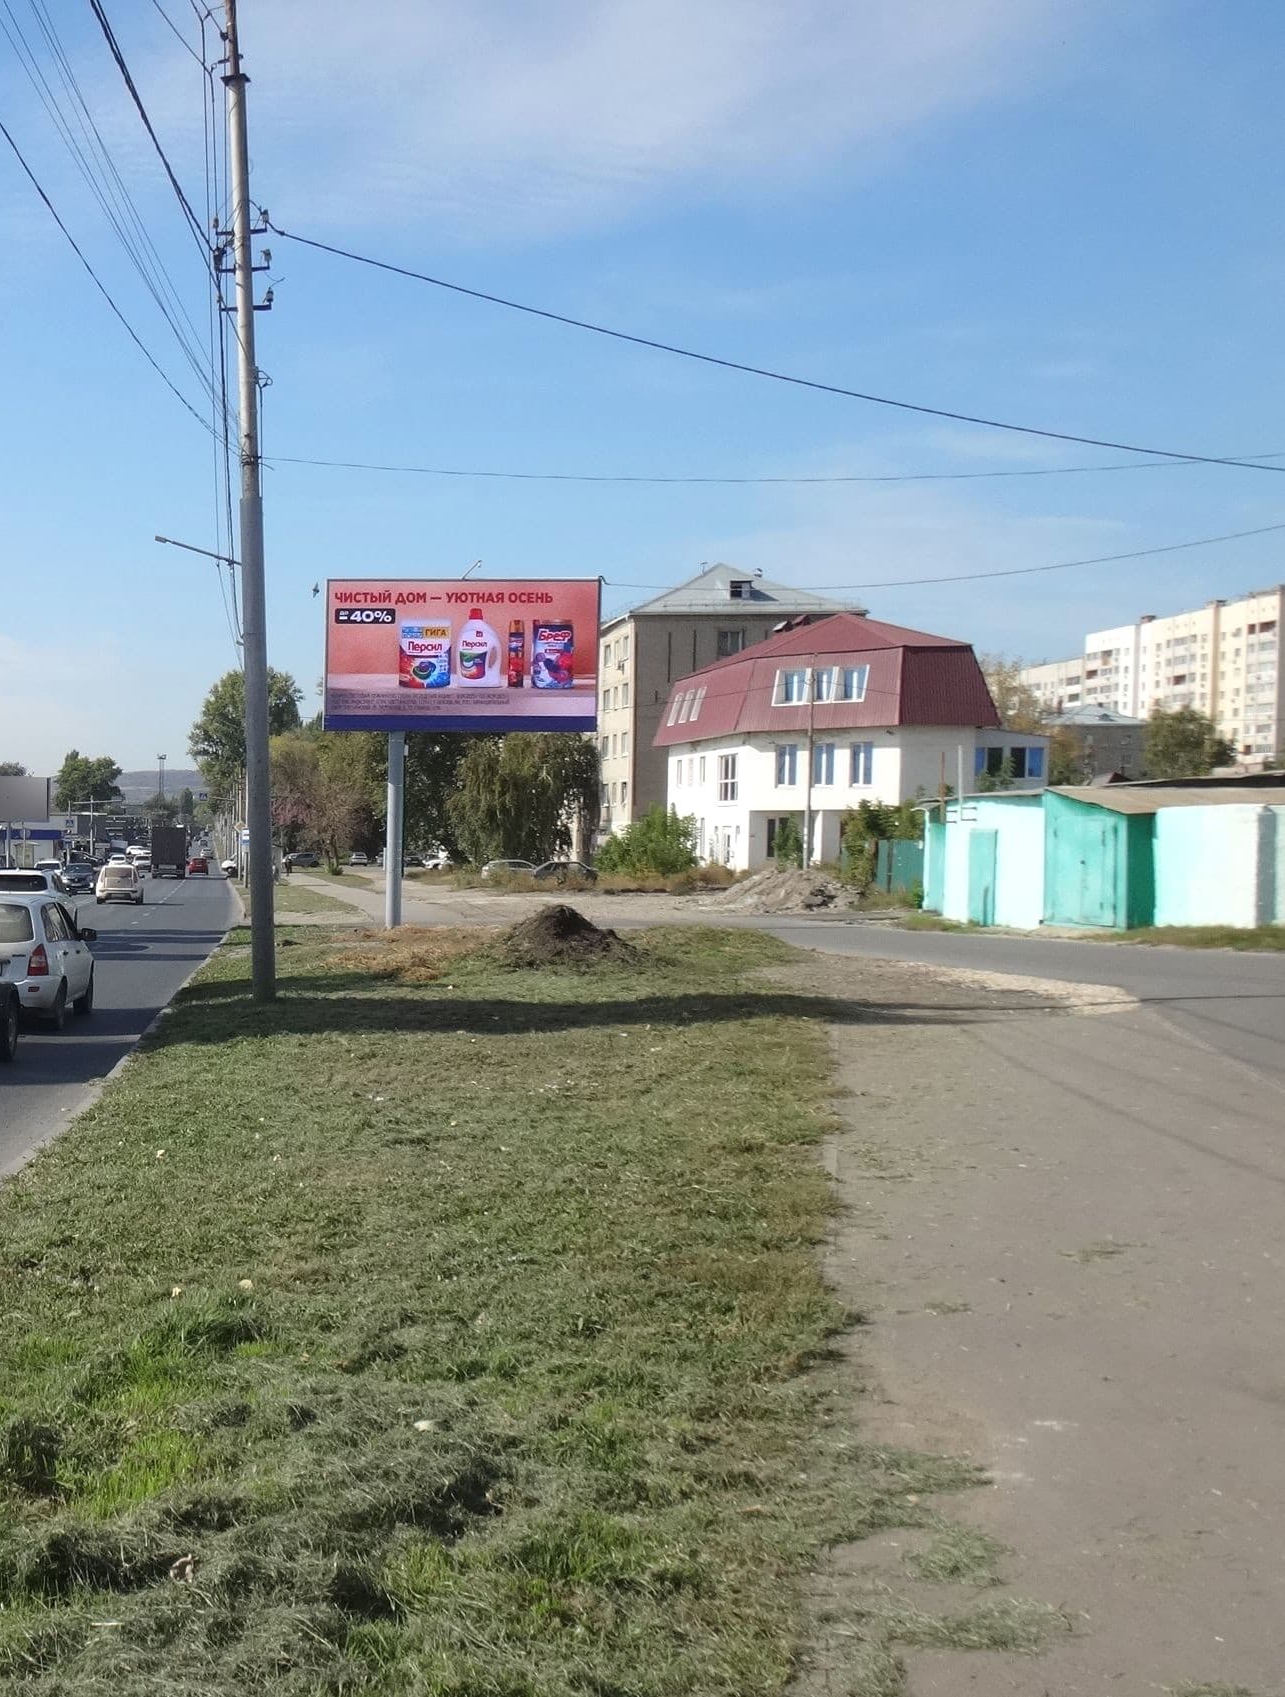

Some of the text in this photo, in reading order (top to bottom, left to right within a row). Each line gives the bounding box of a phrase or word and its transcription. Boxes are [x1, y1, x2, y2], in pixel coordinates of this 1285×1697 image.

[334, 590, 392, 604] ЧИСТЫЙ
[395, 592, 427, 605] ДОМ
[446, 592, 505, 604] УЮТНАЯ
[508, 592, 553, 604] ОСЕНЬ
[425, 628, 447, 637] ГИГА
[408, 641, 443, 653] Персил
[462, 640, 488, 648] Персил
